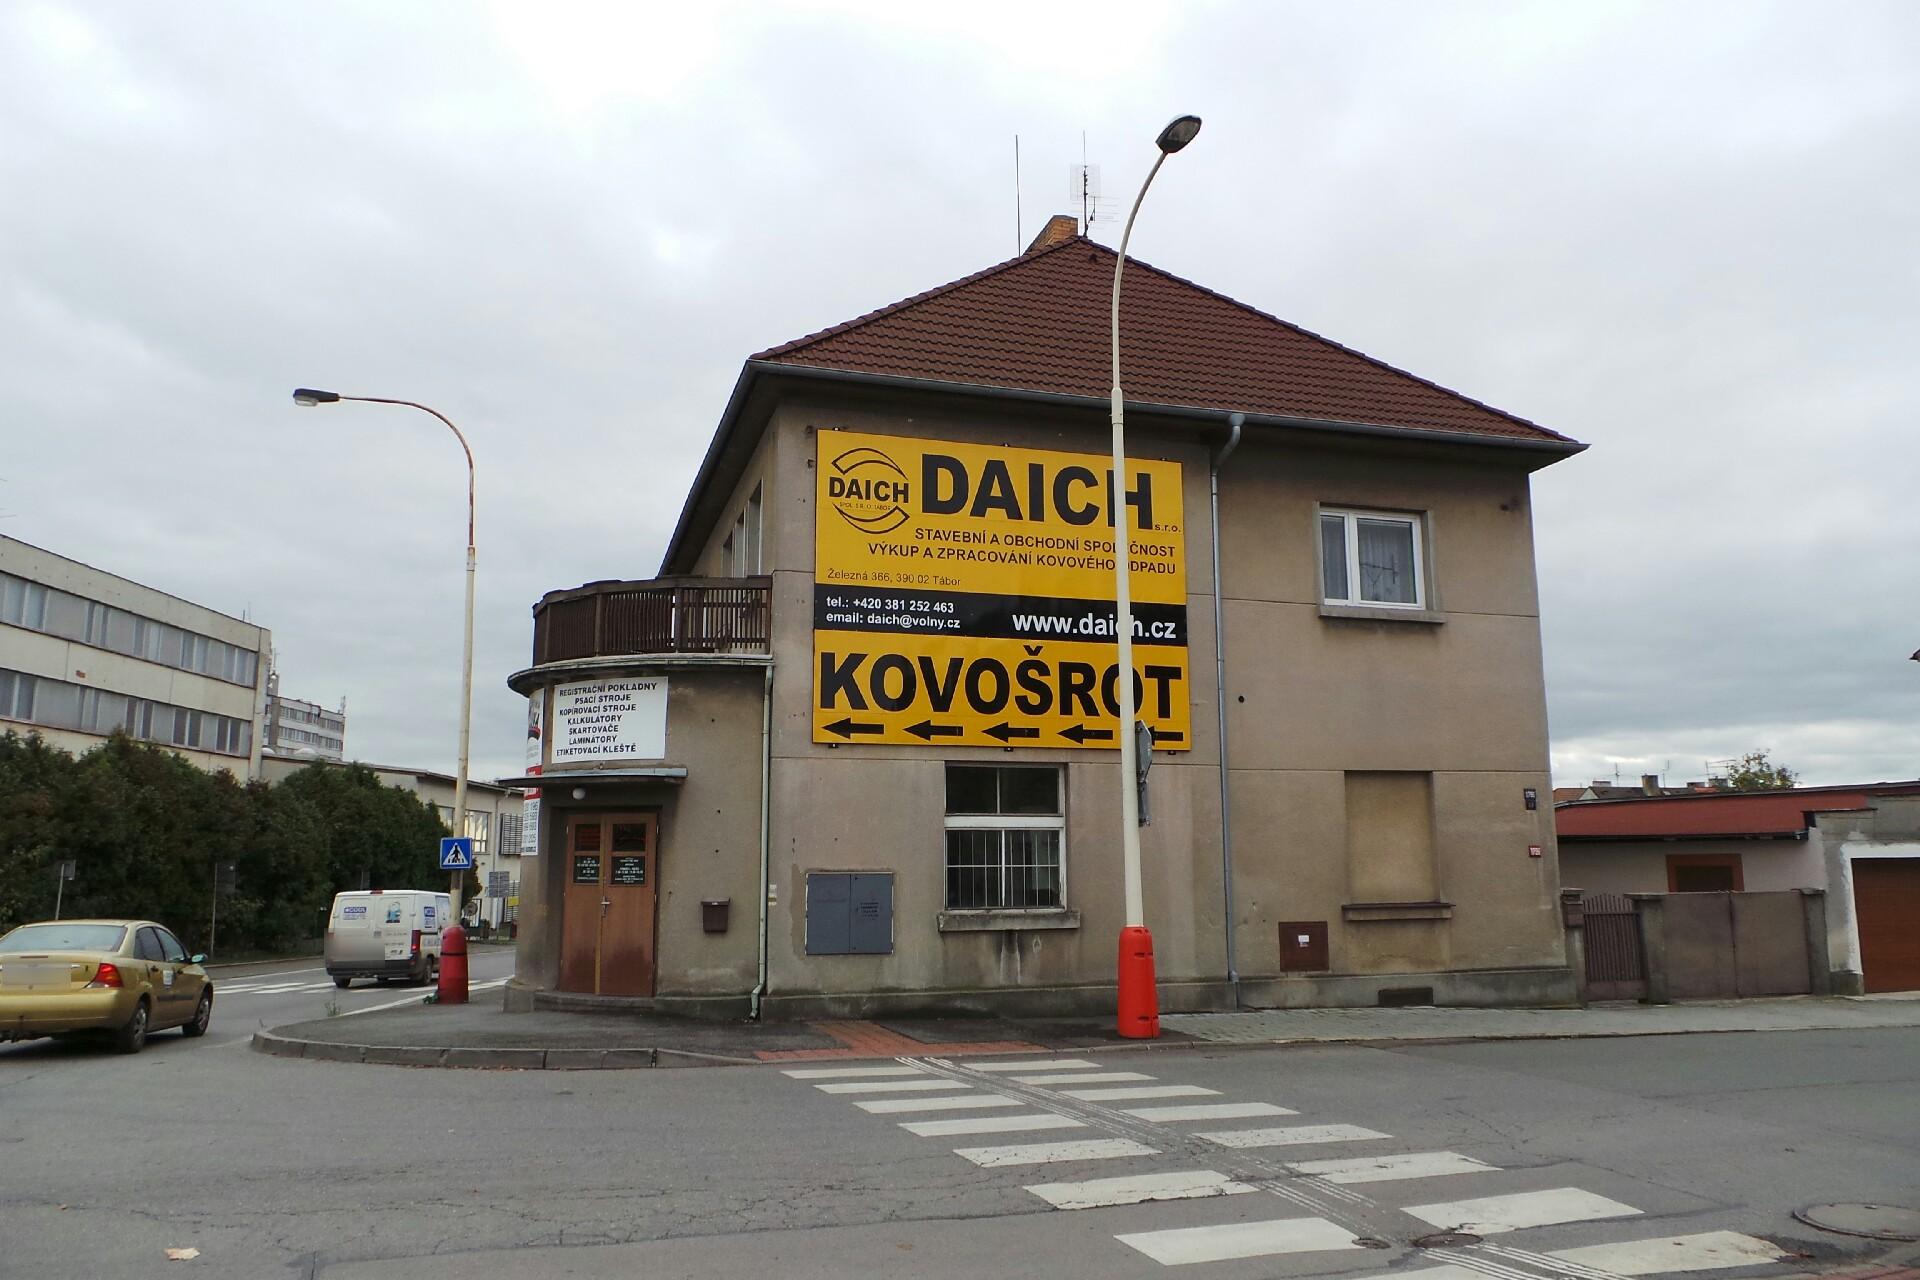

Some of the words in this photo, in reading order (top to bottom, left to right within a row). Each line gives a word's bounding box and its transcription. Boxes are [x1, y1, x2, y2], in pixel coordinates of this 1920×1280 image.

[828, 477, 909, 503] DAICH
[922, 453, 1153, 531] DAICH
[1154, 523, 1181, 533] s.r.o.
[914, 528, 986, 544] STAVEBNÍ
[989, 533, 1000, 545] A
[1004, 534, 1080, 551] OBCHODNÍ
[1083, 539, 1176, 557] SPOČNOST
[868, 541, 919, 557] VÝKUP
[922, 547, 934, 559] A
[937, 547, 1032, 565] ZPRACOVÁNÍ
[1036, 554, 1116, 571] KOVOVÉHO
[1127, 560, 1176, 575] DPADU
[827, 568, 868, 581] Železná
[896, 573, 915, 584] 390
[917, 574, 930, 584] 02
[932, 575, 961, 586] Tábor
[826, 596, 849, 608] tel.:
[853, 598, 882, 610] +420
[885, 599, 905, 611] 381
[909, 600, 930, 612] 252
[933, 602, 954, 613] 463
[826, 611, 864, 624] email:
[867, 613, 961, 629] daich@volny.cz
[1012, 612, 1177, 639] www.daih.cz
[560, 683, 606, 697] REGISTRAČNÍ
[608, 682, 658, 693] POKLADNY
[820, 645, 1182, 719] KOVOŠROT
[575, 694, 596, 705] PSACÍ
[598, 694, 632, 703] STROJE
[560, 704, 601, 716] KOPÍROVACÍ
[603, 703, 637, 713] STROJE
[568, 723, 619, 735] SKARTOVAČE
[556, 745, 601, 757] ETIKETOVACÍ
